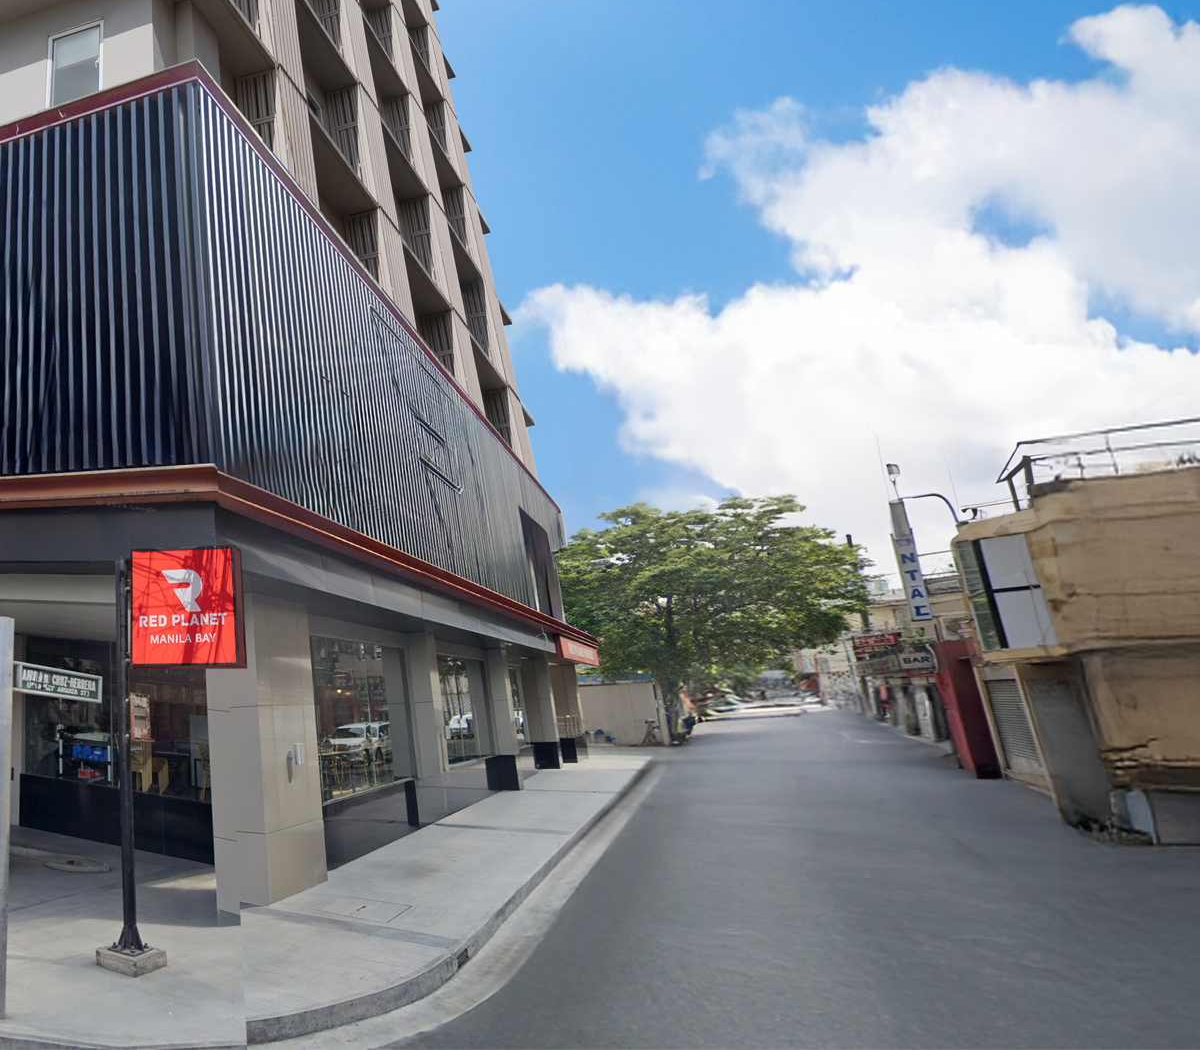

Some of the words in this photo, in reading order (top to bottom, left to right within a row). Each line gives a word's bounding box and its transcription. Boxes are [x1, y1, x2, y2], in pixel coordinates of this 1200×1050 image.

[139, 614, 168, 627] RED
[172, 612, 227, 626] PLANET
[150, 633, 192, 644] MANILA
[195, 633, 217, 643] BAY
[902, 656, 931, 665] BAR
[52, 674, 97, 692] CRUZ-HERRERA
